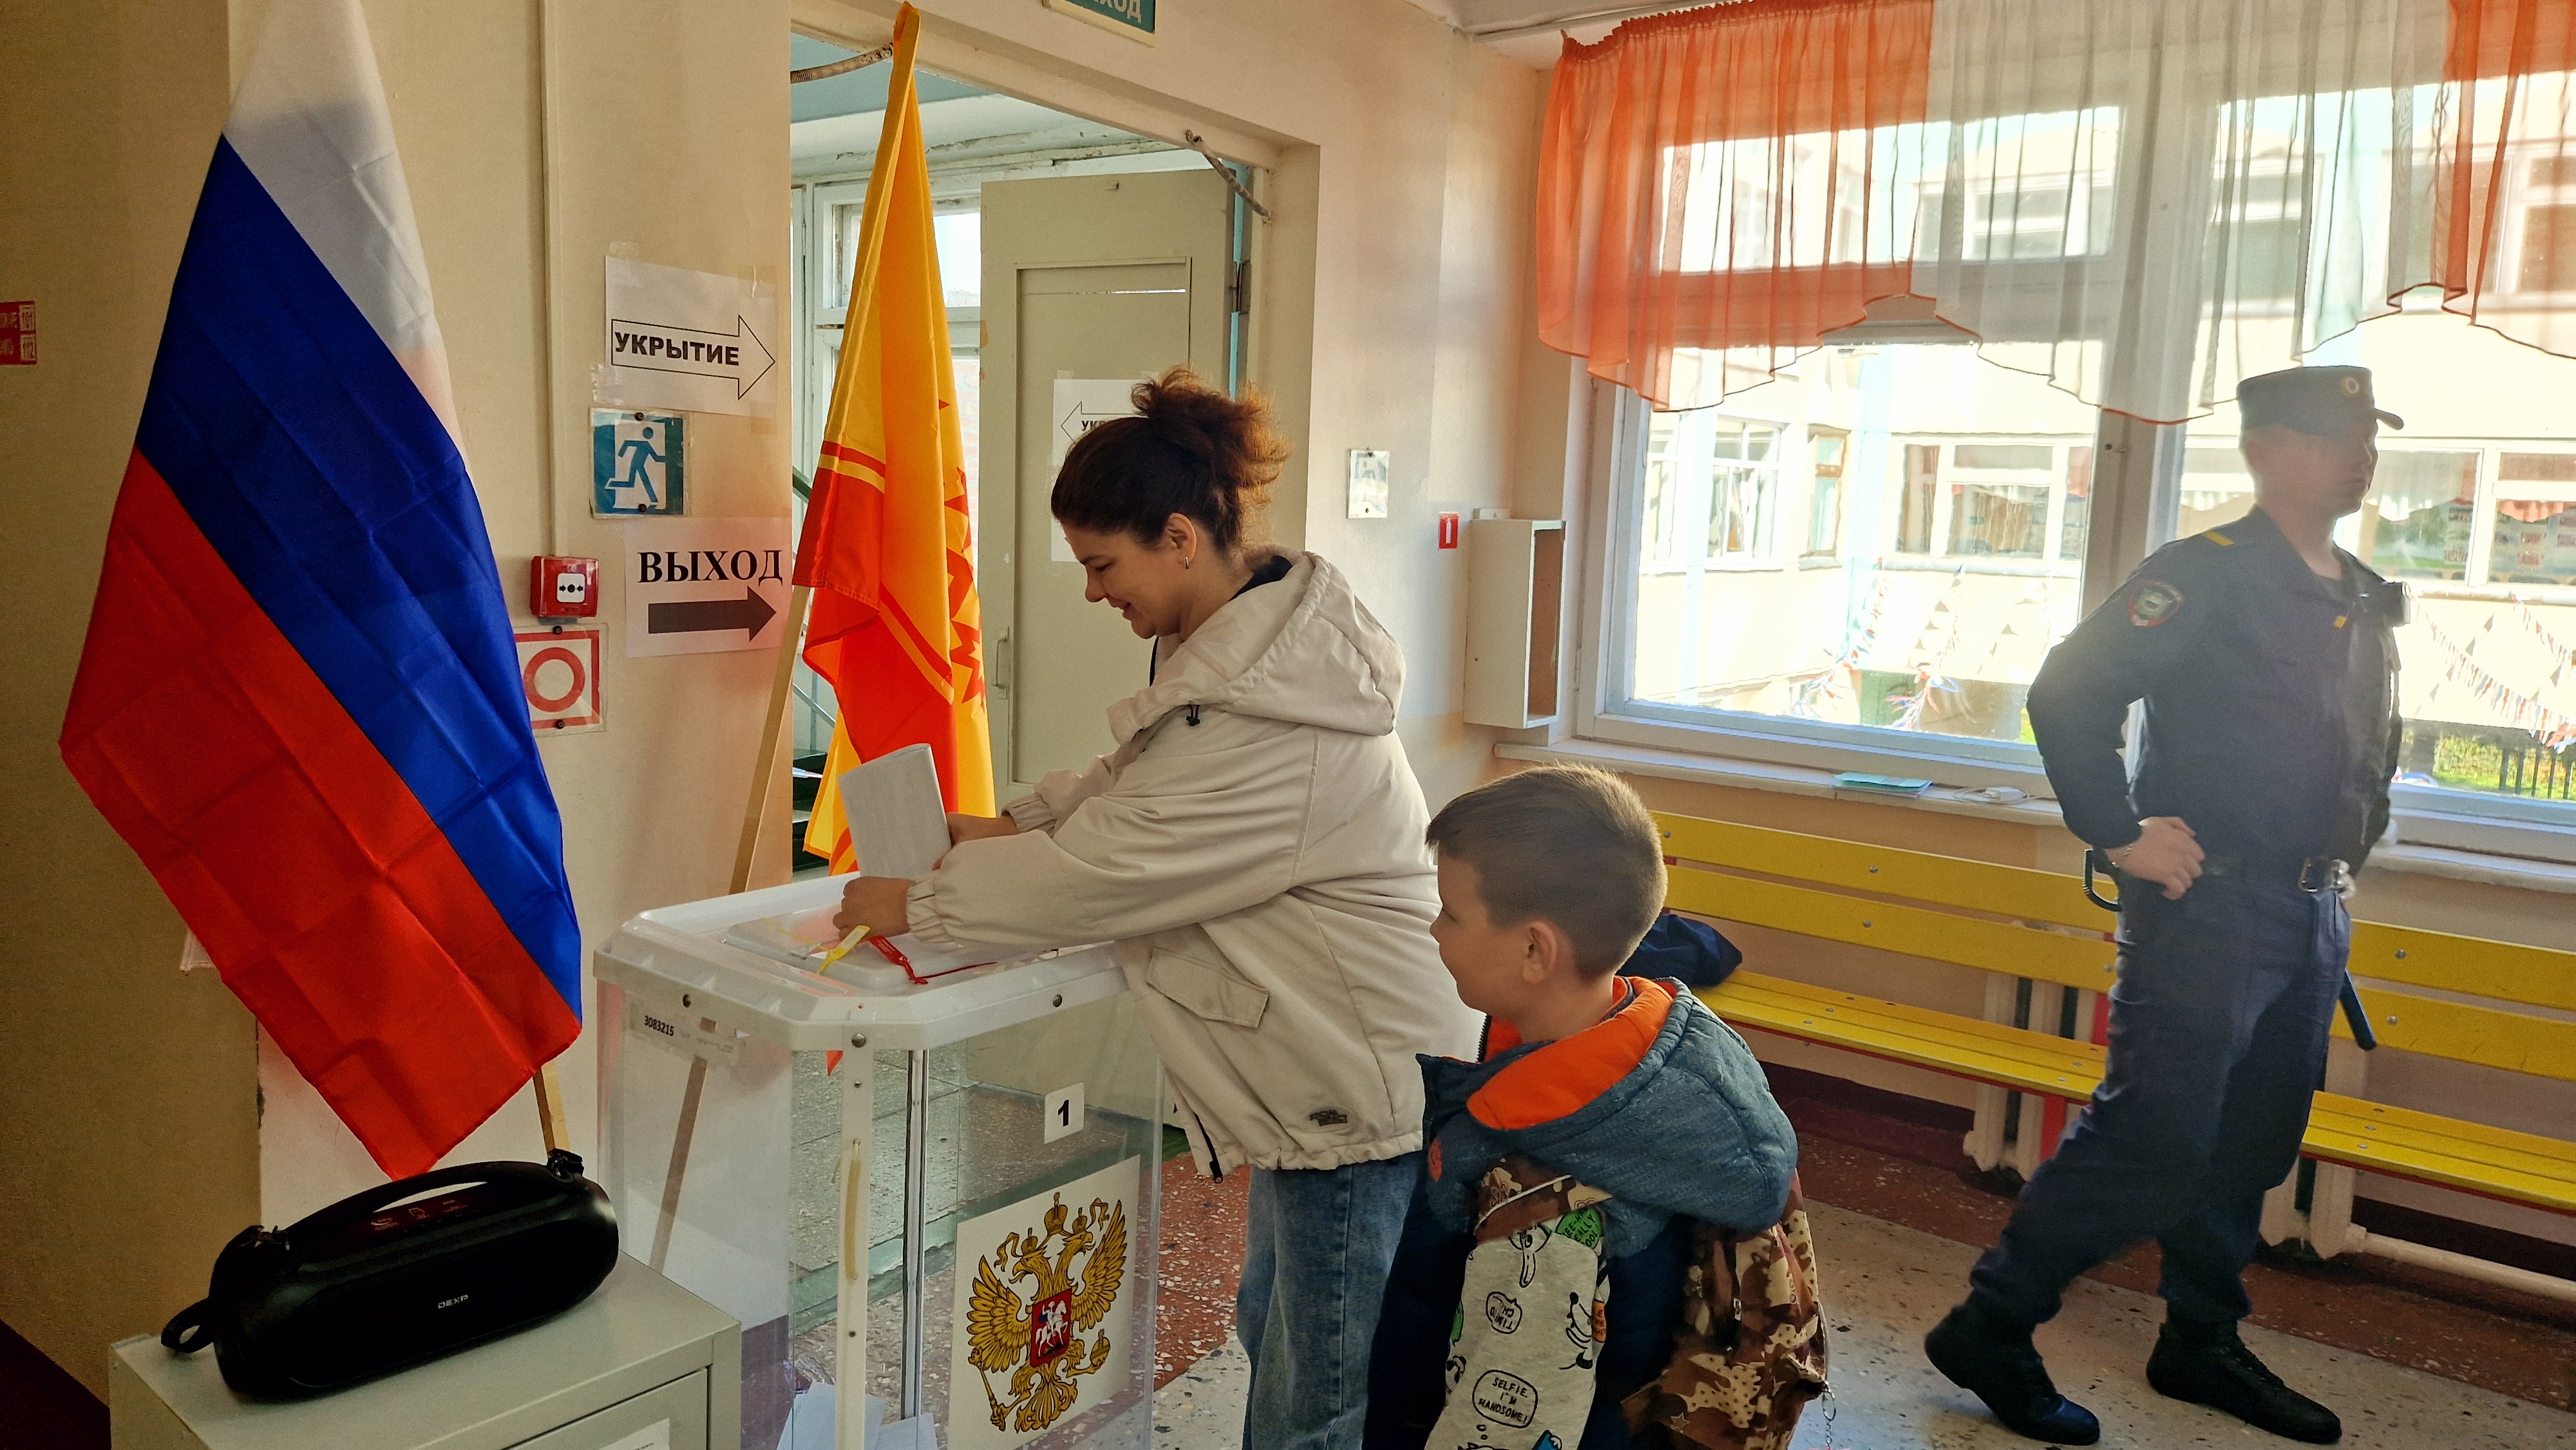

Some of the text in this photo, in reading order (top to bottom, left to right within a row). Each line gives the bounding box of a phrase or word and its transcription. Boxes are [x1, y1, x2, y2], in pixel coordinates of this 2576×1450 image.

[614, 331, 739, 366] УКРЫТИЕ
[637, 550, 783, 587] ВЫХОД
[644, 1015, 674, 1037] 3083215
[1057, 1098, 1069, 1127] 1
[1573, 1214, 1595, 1243] EALLY
[438, 1294, 468, 1309] DEXP
[1492, 1377, 1528, 1398] SELFIE
